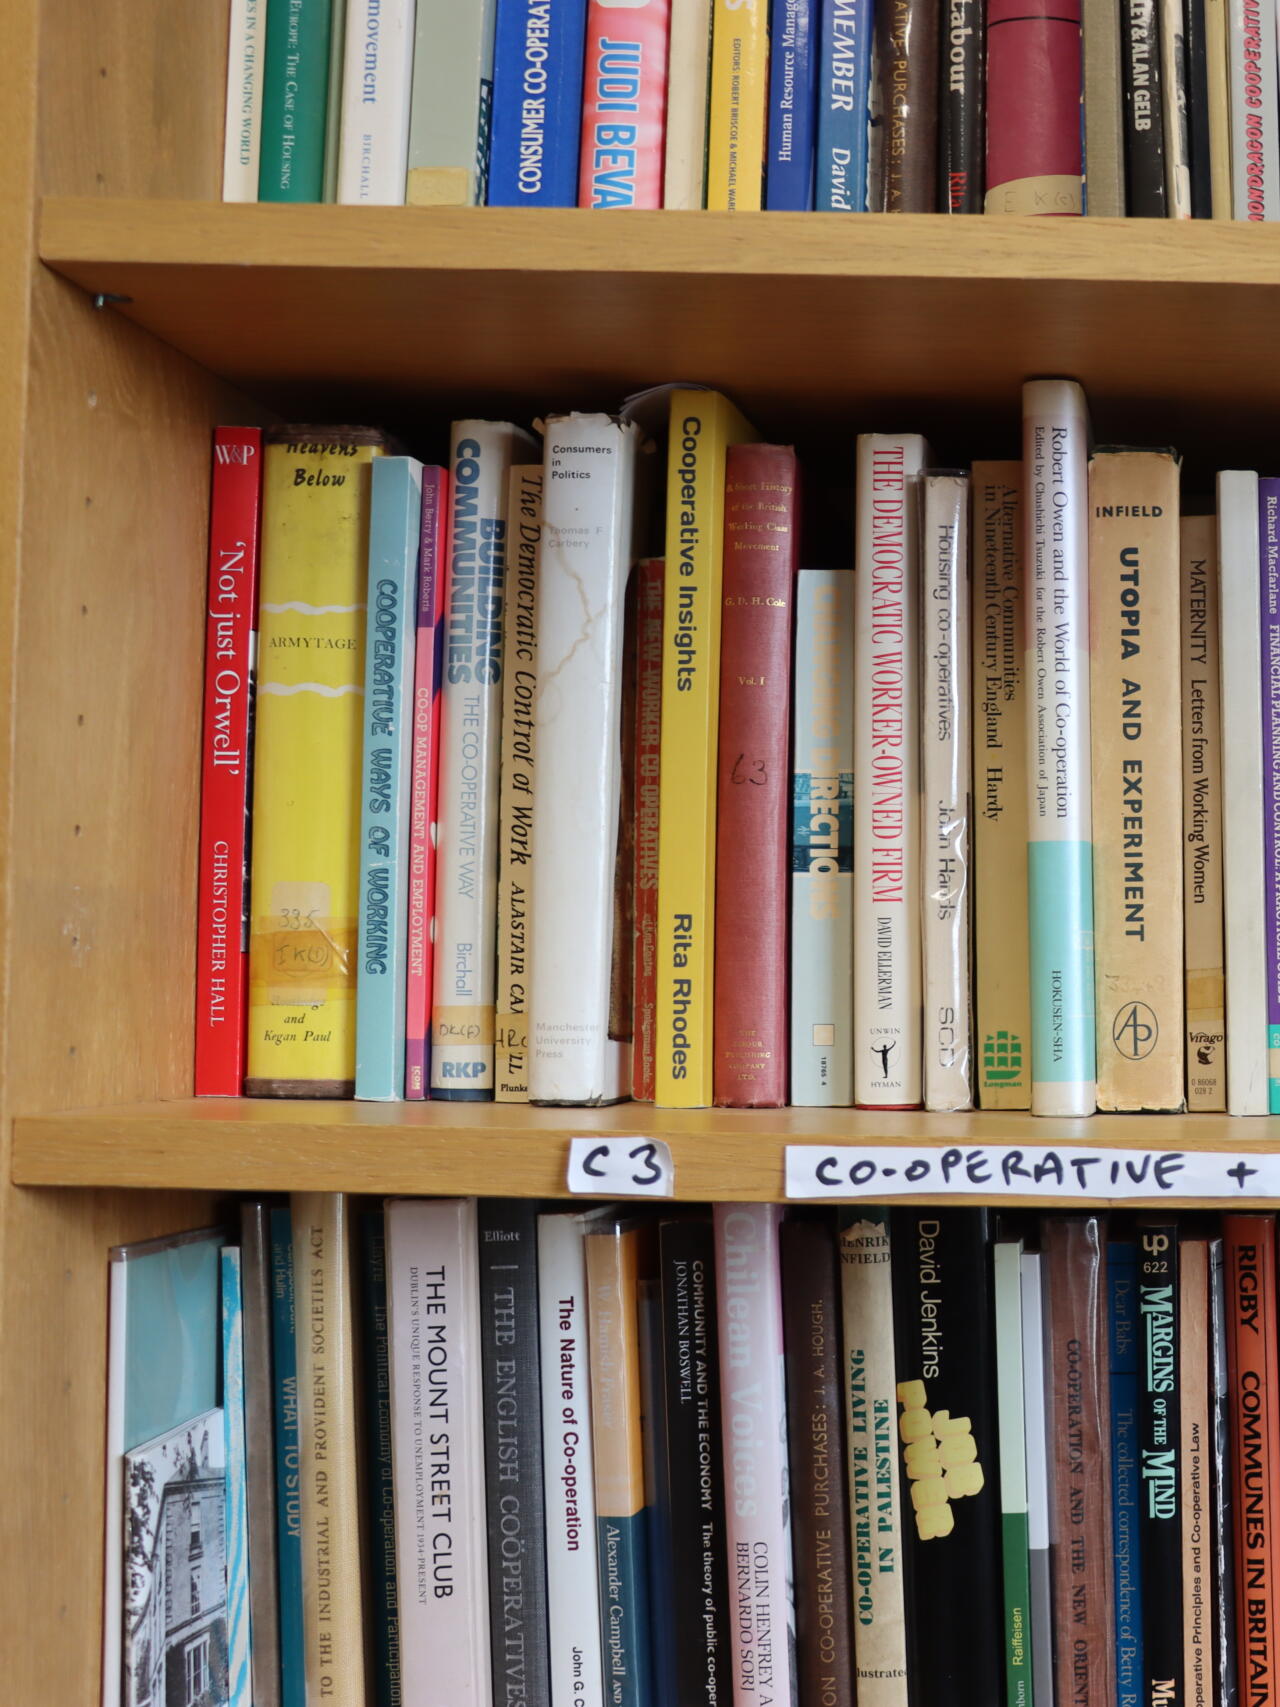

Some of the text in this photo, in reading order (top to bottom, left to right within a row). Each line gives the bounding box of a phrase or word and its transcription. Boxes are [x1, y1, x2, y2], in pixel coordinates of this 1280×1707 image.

[240, 44, 255, 165] CHANGING WORLD
[280, 54, 300, 190] THE CASE OF HOUSING
[597, 38, 641, 112] JUDI
[360, 135, 371, 199] BIRCHALL
[518, 97, 545, 193] CONSUMER
[294, 468, 346, 487] Below
[552, 445, 612, 455] Consumers
[552, 458, 561, 467] in
[552, 470, 590, 480] Politics
[674, 416, 700, 692] Cooperative Insights
[1096, 506, 1163, 517] INFIELD
[1267, 496, 1277, 614] Richard Macfarlane
[210, 611, 241, 660] just
[268, 638, 356, 650] ARMYTAGE
[871, 446, 904, 903] THE DEMOCRATIC WORKER-OWNED FIRM
[1052, 427, 1072, 817] Robert Owen and the World of Co-operation
[366, 579, 397, 975] COOPERATIVE WAYS OF WORKING
[1120, 547, 1145, 941] UTOPIA AND EXPERIMENT
[1188, 559, 1210, 904] MATERNITY Letters from Working Women
[211, 841, 228, 1027] CHRISTOPHER HALL
[877, 917, 892, 1009] DAVID ELLERMAN
[672, 914, 692, 1080] Rita Rhodes
[442, 1061, 486, 1078] RKP
[815, 1149, 1186, 1189] CO-OPERATIVE
[484, 1230, 520, 1242] Elliott
[1144, 1262, 1168, 1273] 622
[1238, 1245, 1259, 1336] RIGBY
[673, 1260, 692, 1403] JONATHAN BOSWELL
[918, 1220, 943, 1379] David Jenkins
[426, 1265, 453, 1599] THE MOUNT STREET CLUB
[559, 1296, 579, 1552] The Nature of Co-operation
[1140, 1284, 1176, 1519] MARGINS OF THE MIND
[606, 1524, 626, 1675] Alexander Campbell
